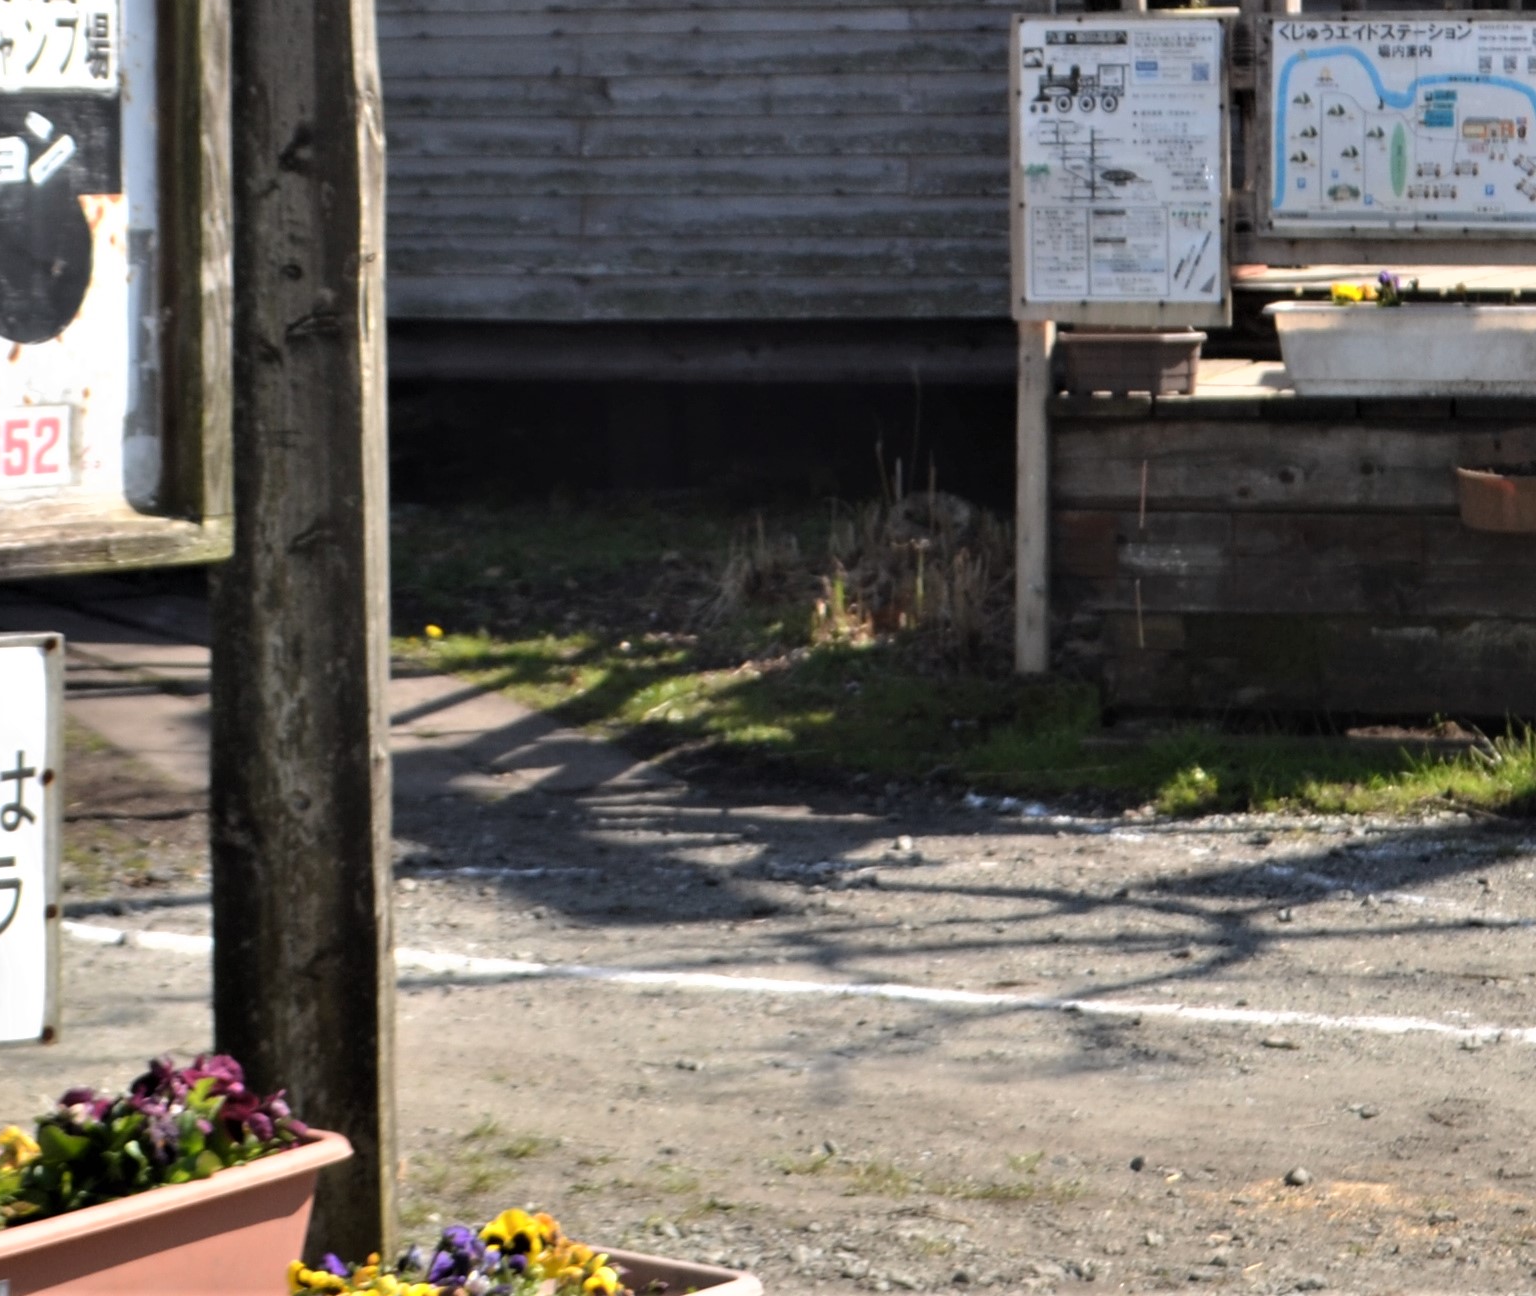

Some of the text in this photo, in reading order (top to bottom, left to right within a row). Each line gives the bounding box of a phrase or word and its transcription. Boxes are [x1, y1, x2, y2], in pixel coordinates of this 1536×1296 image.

[1277, 23, 1473, 41] くじゅうエイドステーション
[1377, 44, 1433, 59] 場内案内
